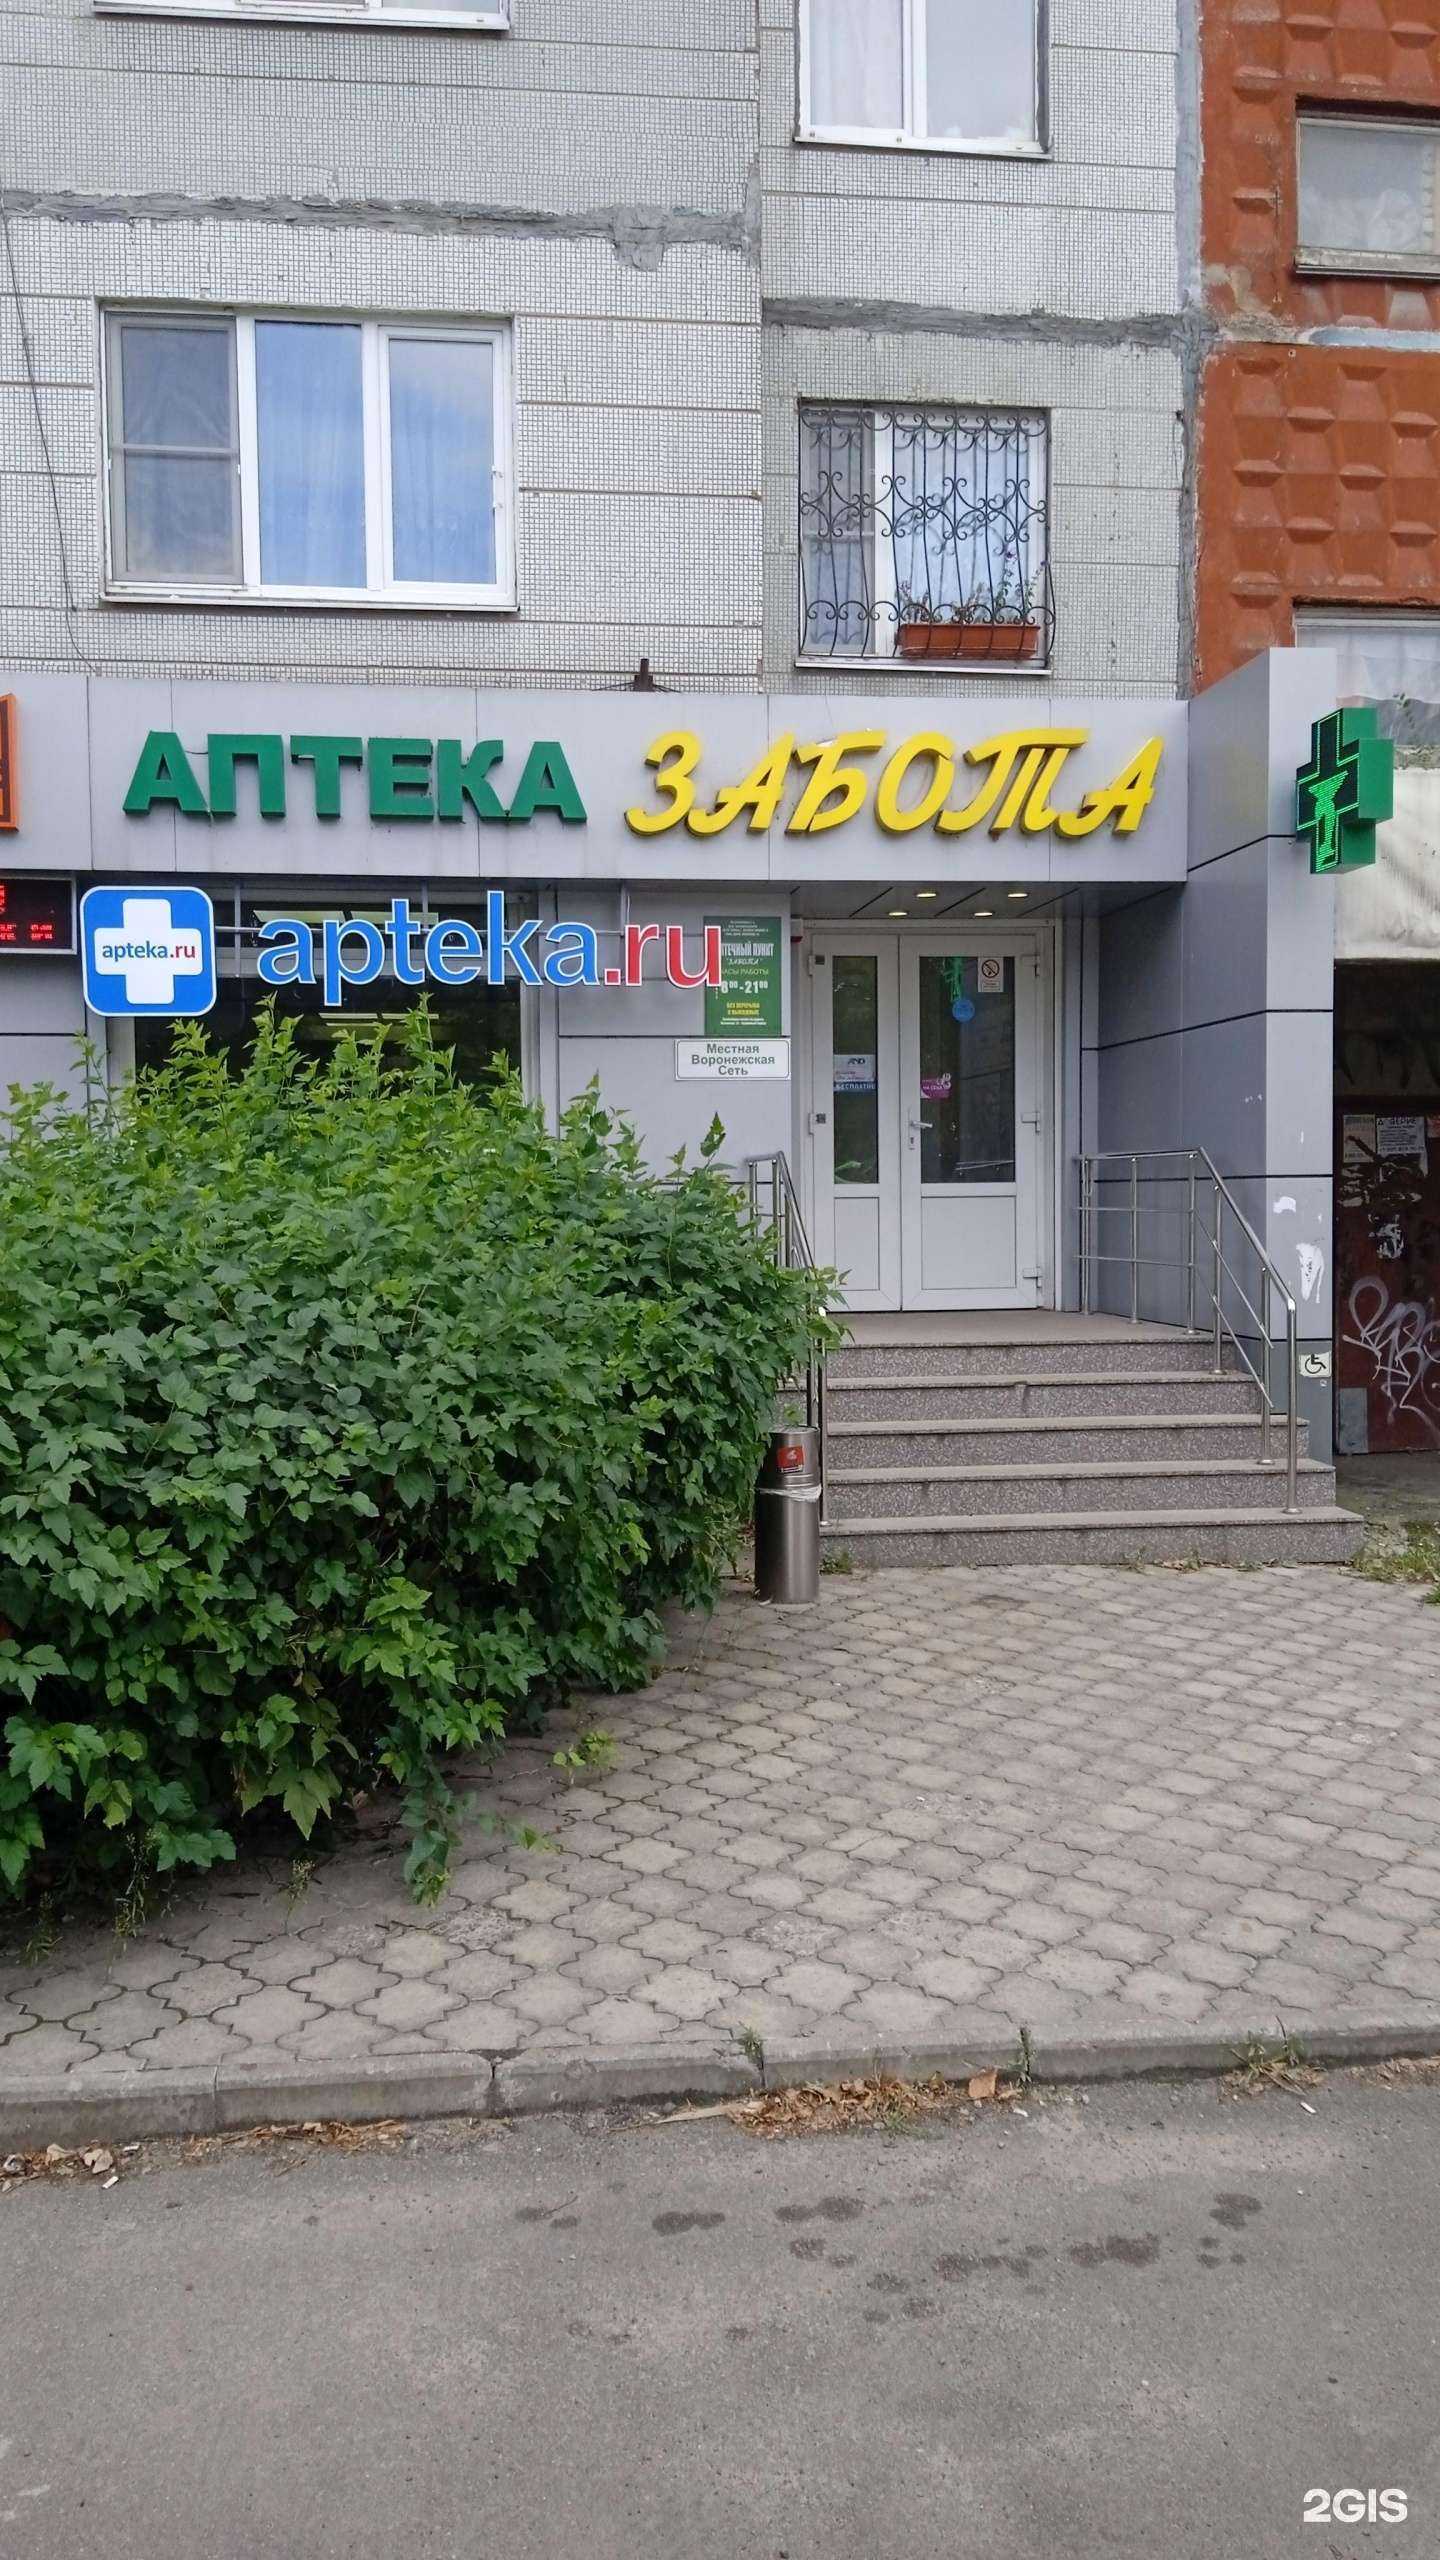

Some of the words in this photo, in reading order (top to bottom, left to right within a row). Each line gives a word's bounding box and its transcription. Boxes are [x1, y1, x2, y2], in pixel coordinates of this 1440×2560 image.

[123, 730, 587, 823] АПТЕКА
[623, 727, 1164, 839] ЗАБОТА
[102, 940, 196, 962] apteka.ru
[256, 890, 722, 1007] apteka.ru
[740, 968, 769, 976] РАБОТЫ
[706, 1043, 760, 1054] Местная
[691, 1054, 775, 1067] Воронежская
[718, 1065, 749, 1076] Сеть
